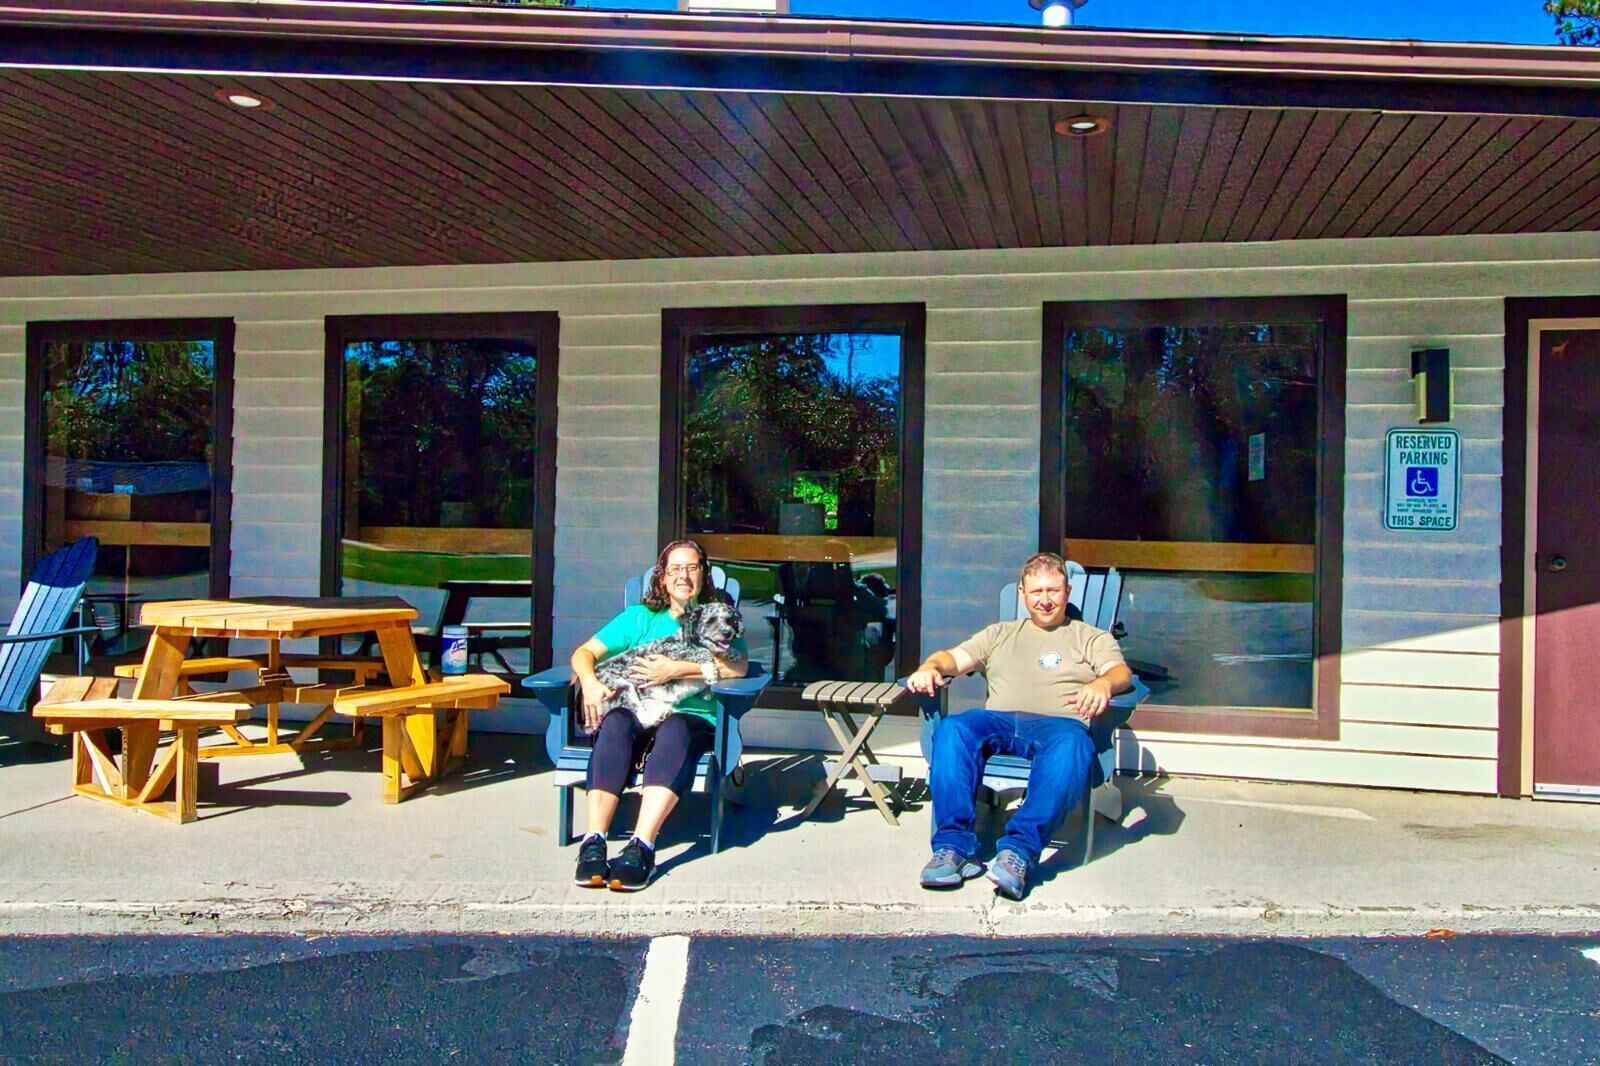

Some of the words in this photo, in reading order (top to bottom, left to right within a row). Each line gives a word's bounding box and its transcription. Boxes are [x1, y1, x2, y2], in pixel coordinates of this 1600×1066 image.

[1396, 435, 1452, 449] RESERVED
[1400, 451, 1448, 465] PARKING
[1392, 515, 1414, 526] THIS
[1419, 516, 1452, 526] SPACE
